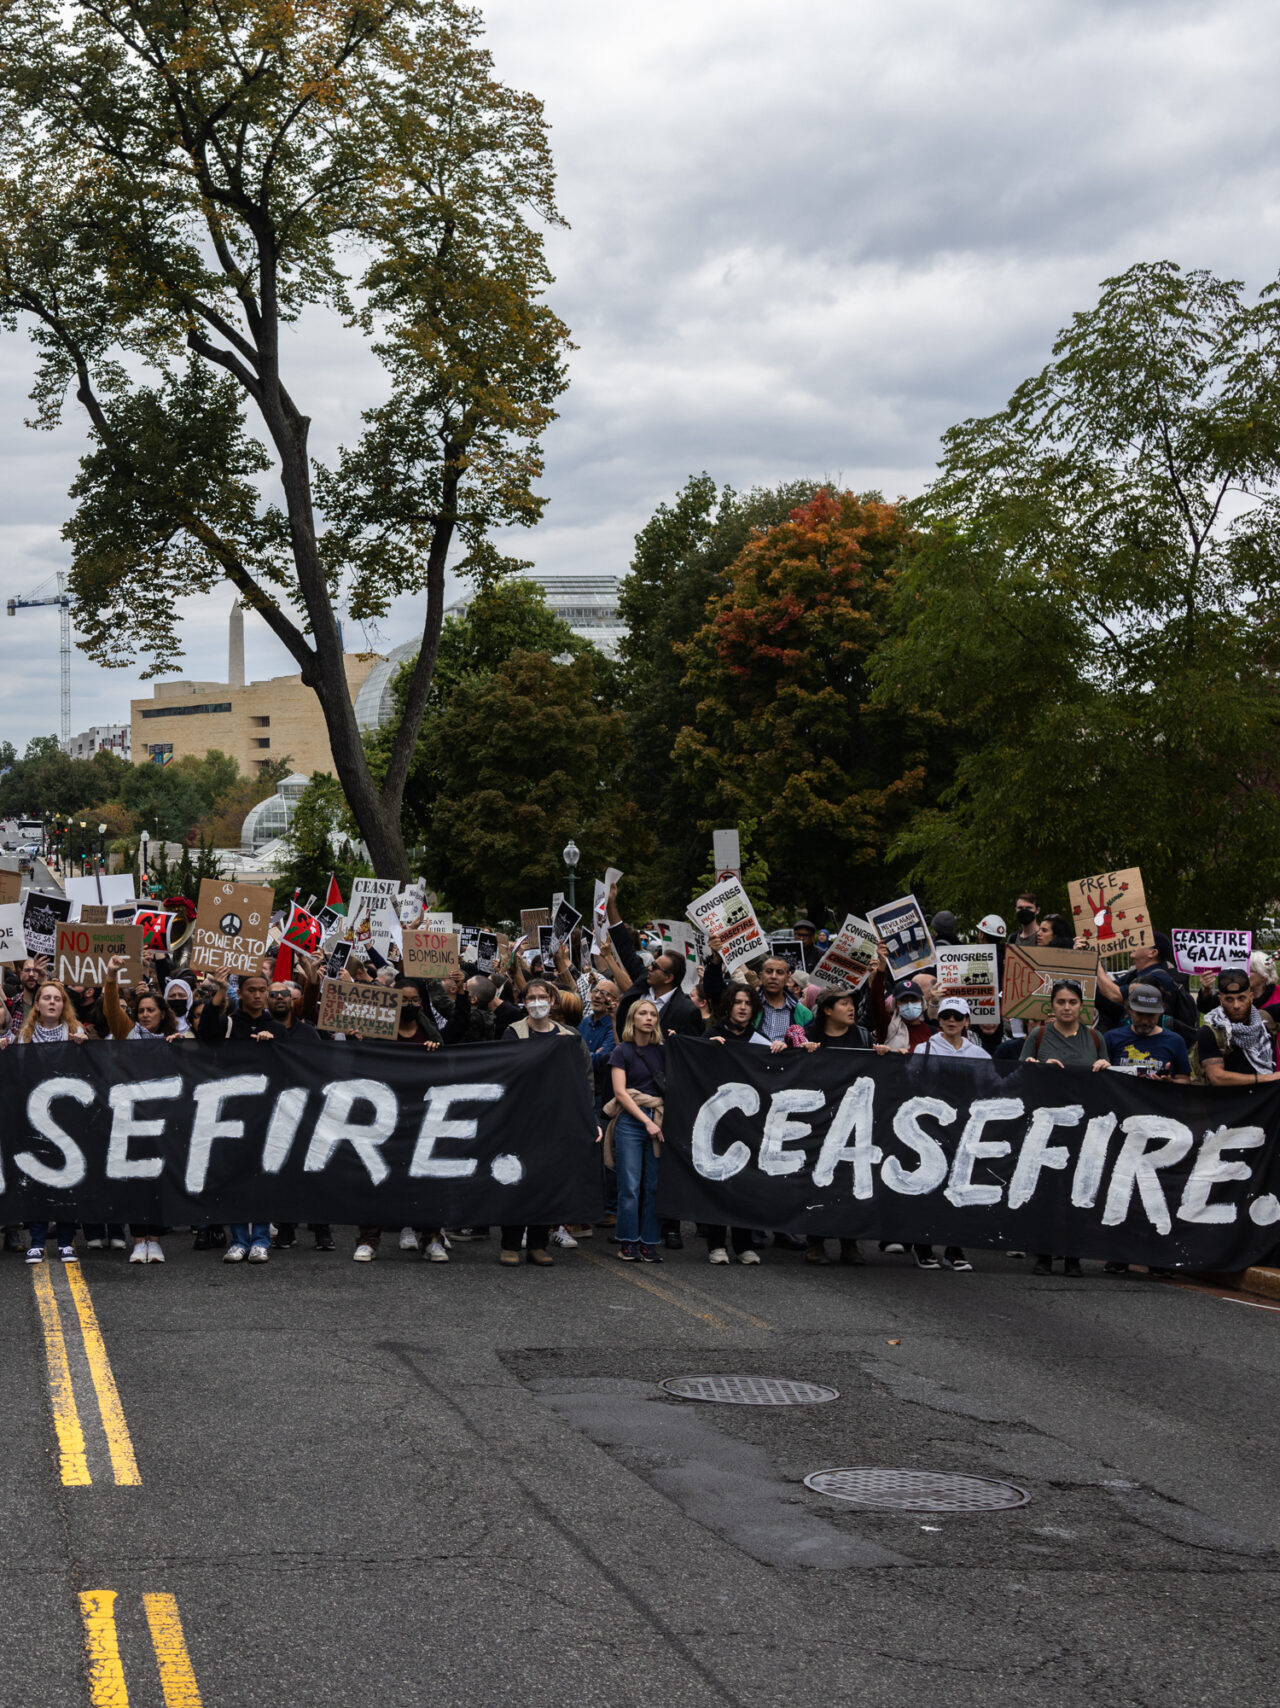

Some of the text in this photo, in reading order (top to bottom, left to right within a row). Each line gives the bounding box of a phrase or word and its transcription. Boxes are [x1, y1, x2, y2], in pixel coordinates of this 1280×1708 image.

[354, 880, 395, 896] CEASE
[1079, 872, 1118, 895] FREE
[360, 896, 388, 911] FIRE
[695, 885, 741, 917] CONGRESS
[701, 911, 718, 925] PICK
[720, 918, 755, 943] EASEFIRE
[60, 930, 90, 954] NO
[94, 944, 126, 954] IN OUR
[197, 928, 265, 956] POWER TO
[415, 934, 449, 950] STOP
[724, 937, 763, 965] GENOCIDE
[729, 935, 746, 950] NOT
[192, 946, 259, 973] THE PEOPLE
[408, 949, 455, 964] BOMBING
[940, 952, 994, 962] CONGRESS
[1175, 943, 1251, 963] IN GAZA NOW
[58, 954, 132, 984] NAME
[419, 963, 449, 976] GAZA
[831, 966, 849, 978] NOT
[1004, 956, 1035, 1004] FREE
[327, 983, 399, 1008] BLACK IS
[322, 1011, 394, 1030] PALESTINIAN
[378, 1007, 396, 1023] IS
[692, 1076, 1280, 1236] CEASEFIRE.
